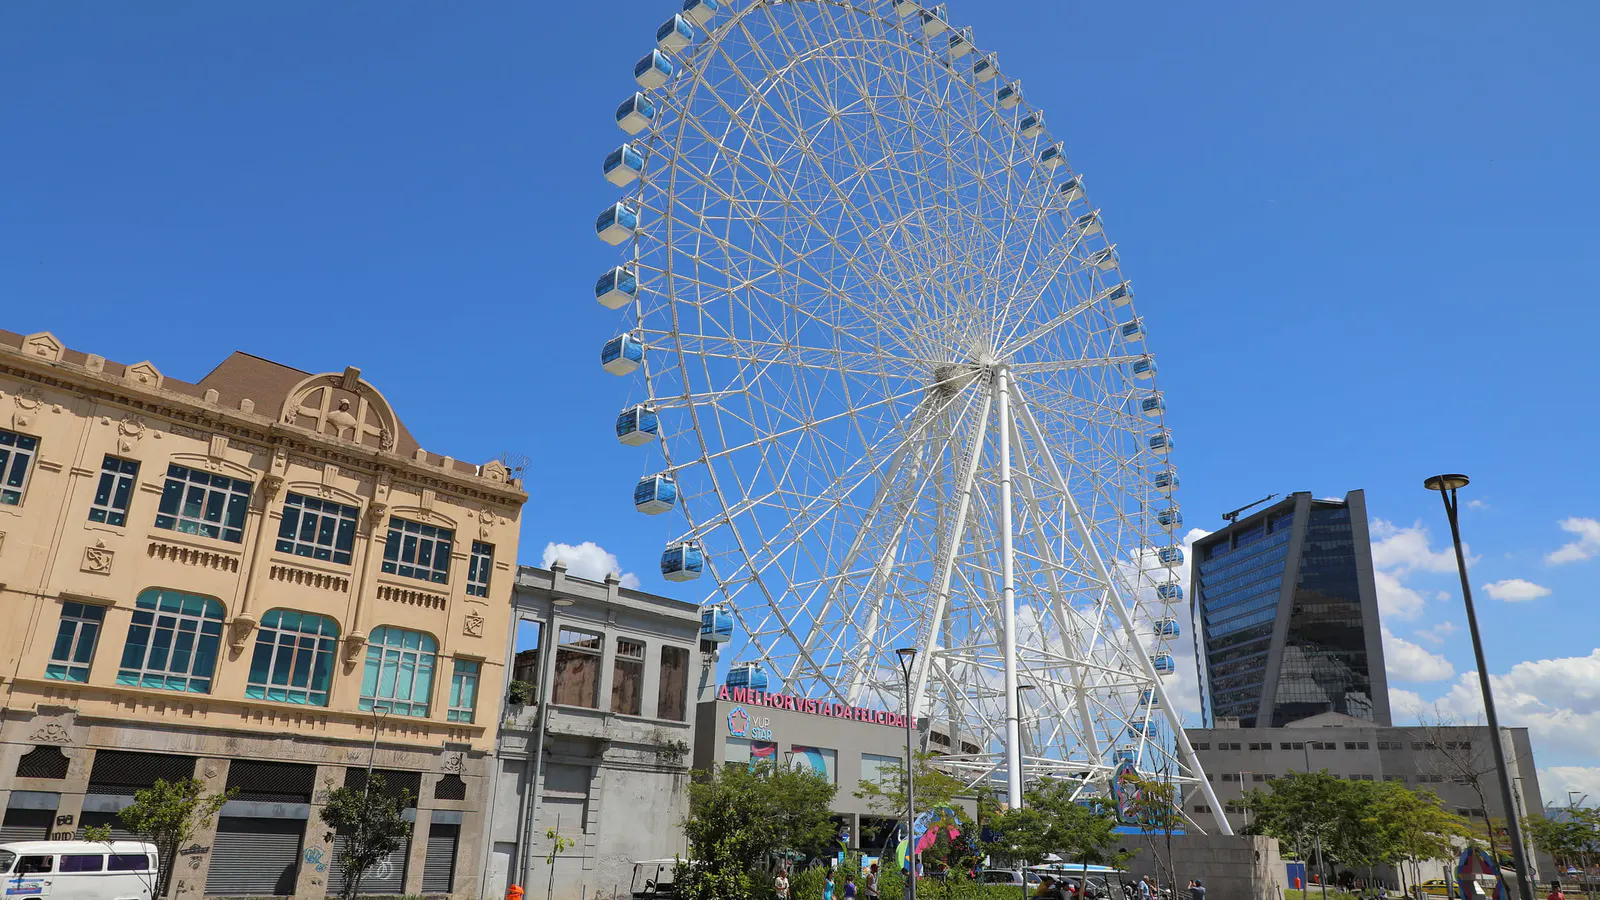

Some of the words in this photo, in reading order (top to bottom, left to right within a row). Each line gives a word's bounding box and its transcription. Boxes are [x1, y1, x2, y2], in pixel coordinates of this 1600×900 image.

[719, 685, 729, 700] A
[733, 687, 793, 710] MELHOR
[796, 697, 832, 716] VISTA
[834, 704, 852, 720] DA
[752, 716, 770, 728] YUP
[751, 727, 772, 741] STAR
